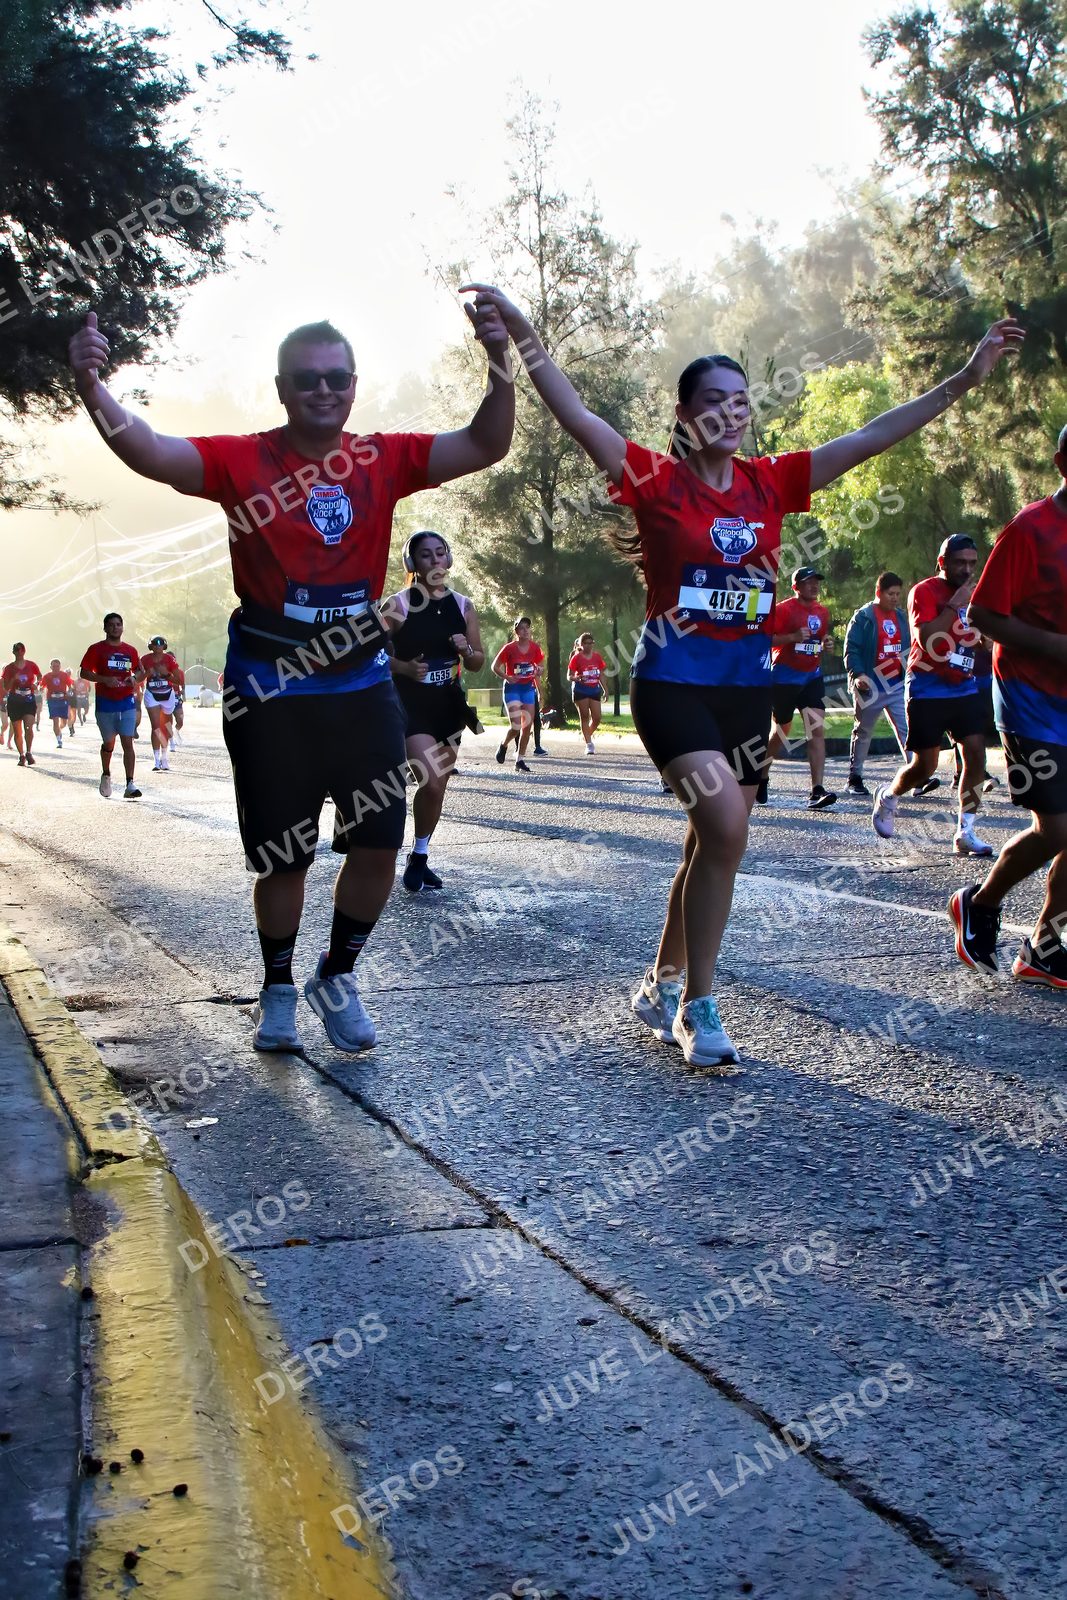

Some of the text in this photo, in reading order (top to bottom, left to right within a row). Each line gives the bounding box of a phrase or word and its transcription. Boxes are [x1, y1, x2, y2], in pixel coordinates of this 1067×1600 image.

[315, 490, 338, 498] BIMBO
[317, 499, 341, 511] Global
[313, 508, 333, 518] Race
[708, 590, 746, 611] 4162
[430, 669, 450, 682] 4535
